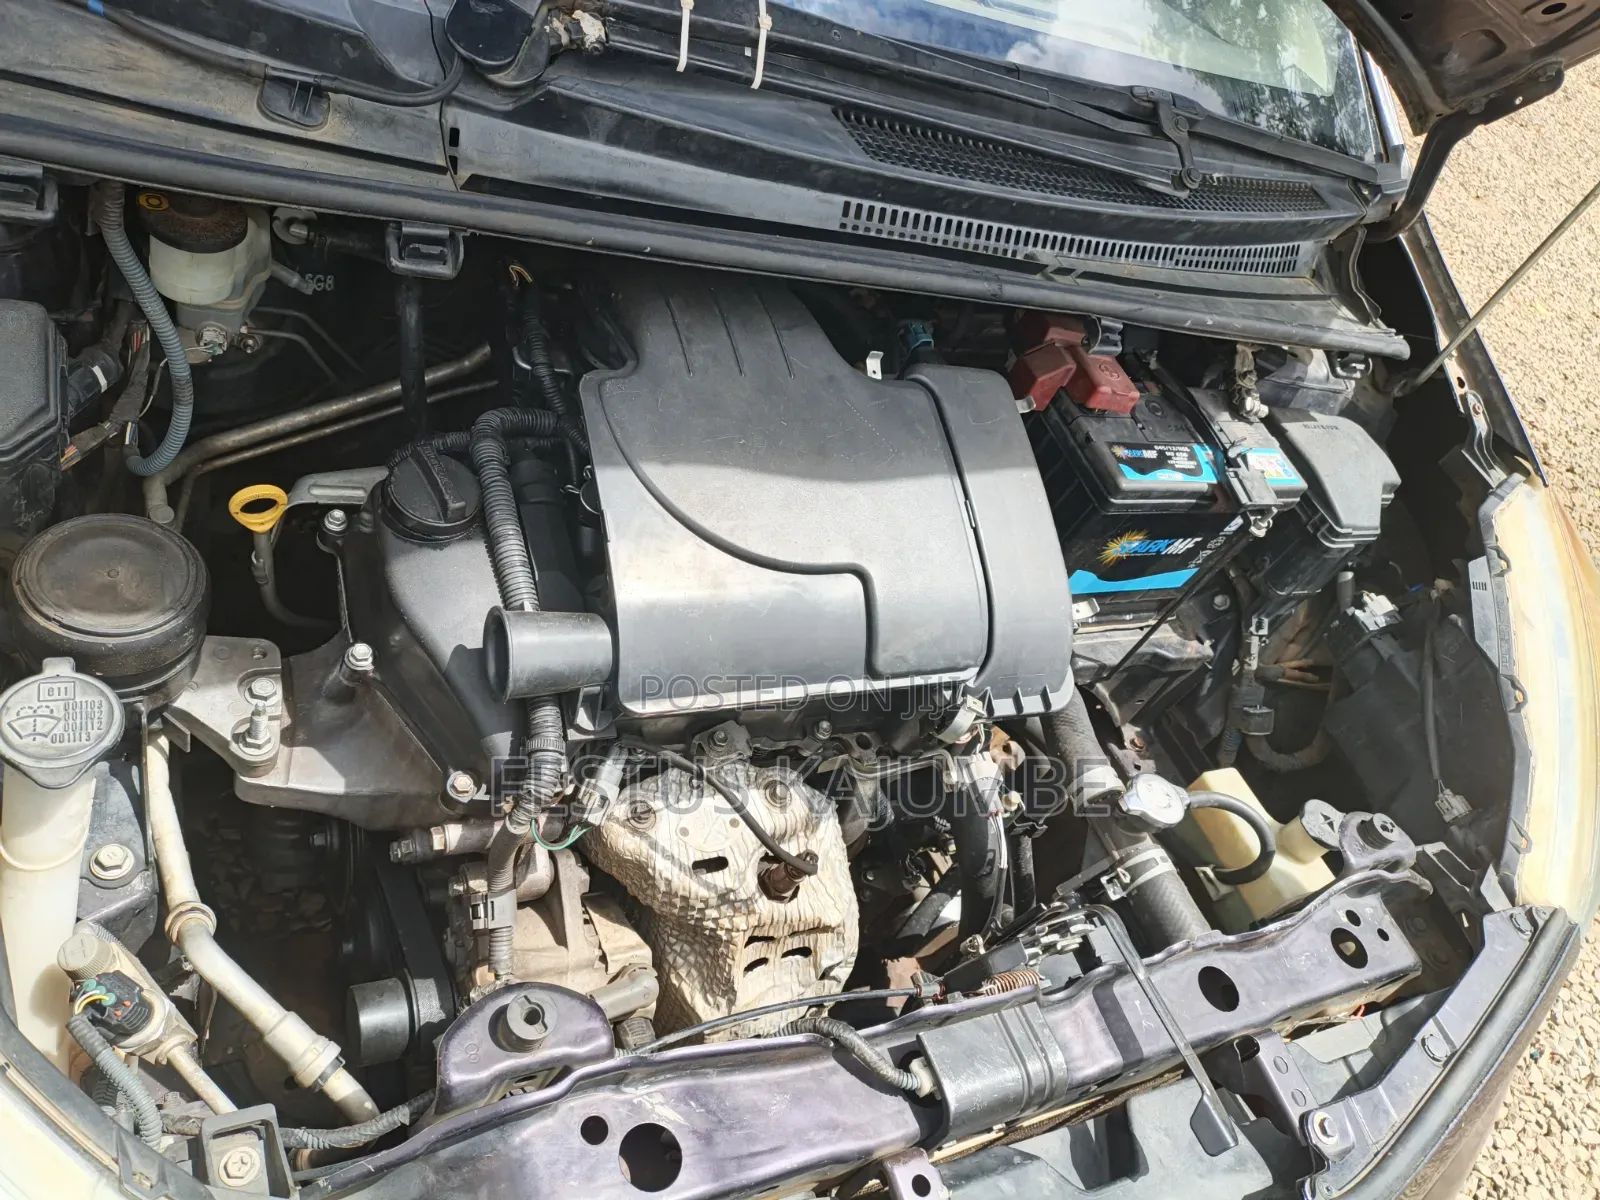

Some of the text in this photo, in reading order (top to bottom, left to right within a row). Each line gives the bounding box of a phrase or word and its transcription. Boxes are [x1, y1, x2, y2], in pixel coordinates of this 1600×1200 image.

[63, 699, 104, 711] 001103
[63, 709, 104, 721] 001102
[63, 720, 104, 732] 001112
[50, 731, 91, 744] 001113
